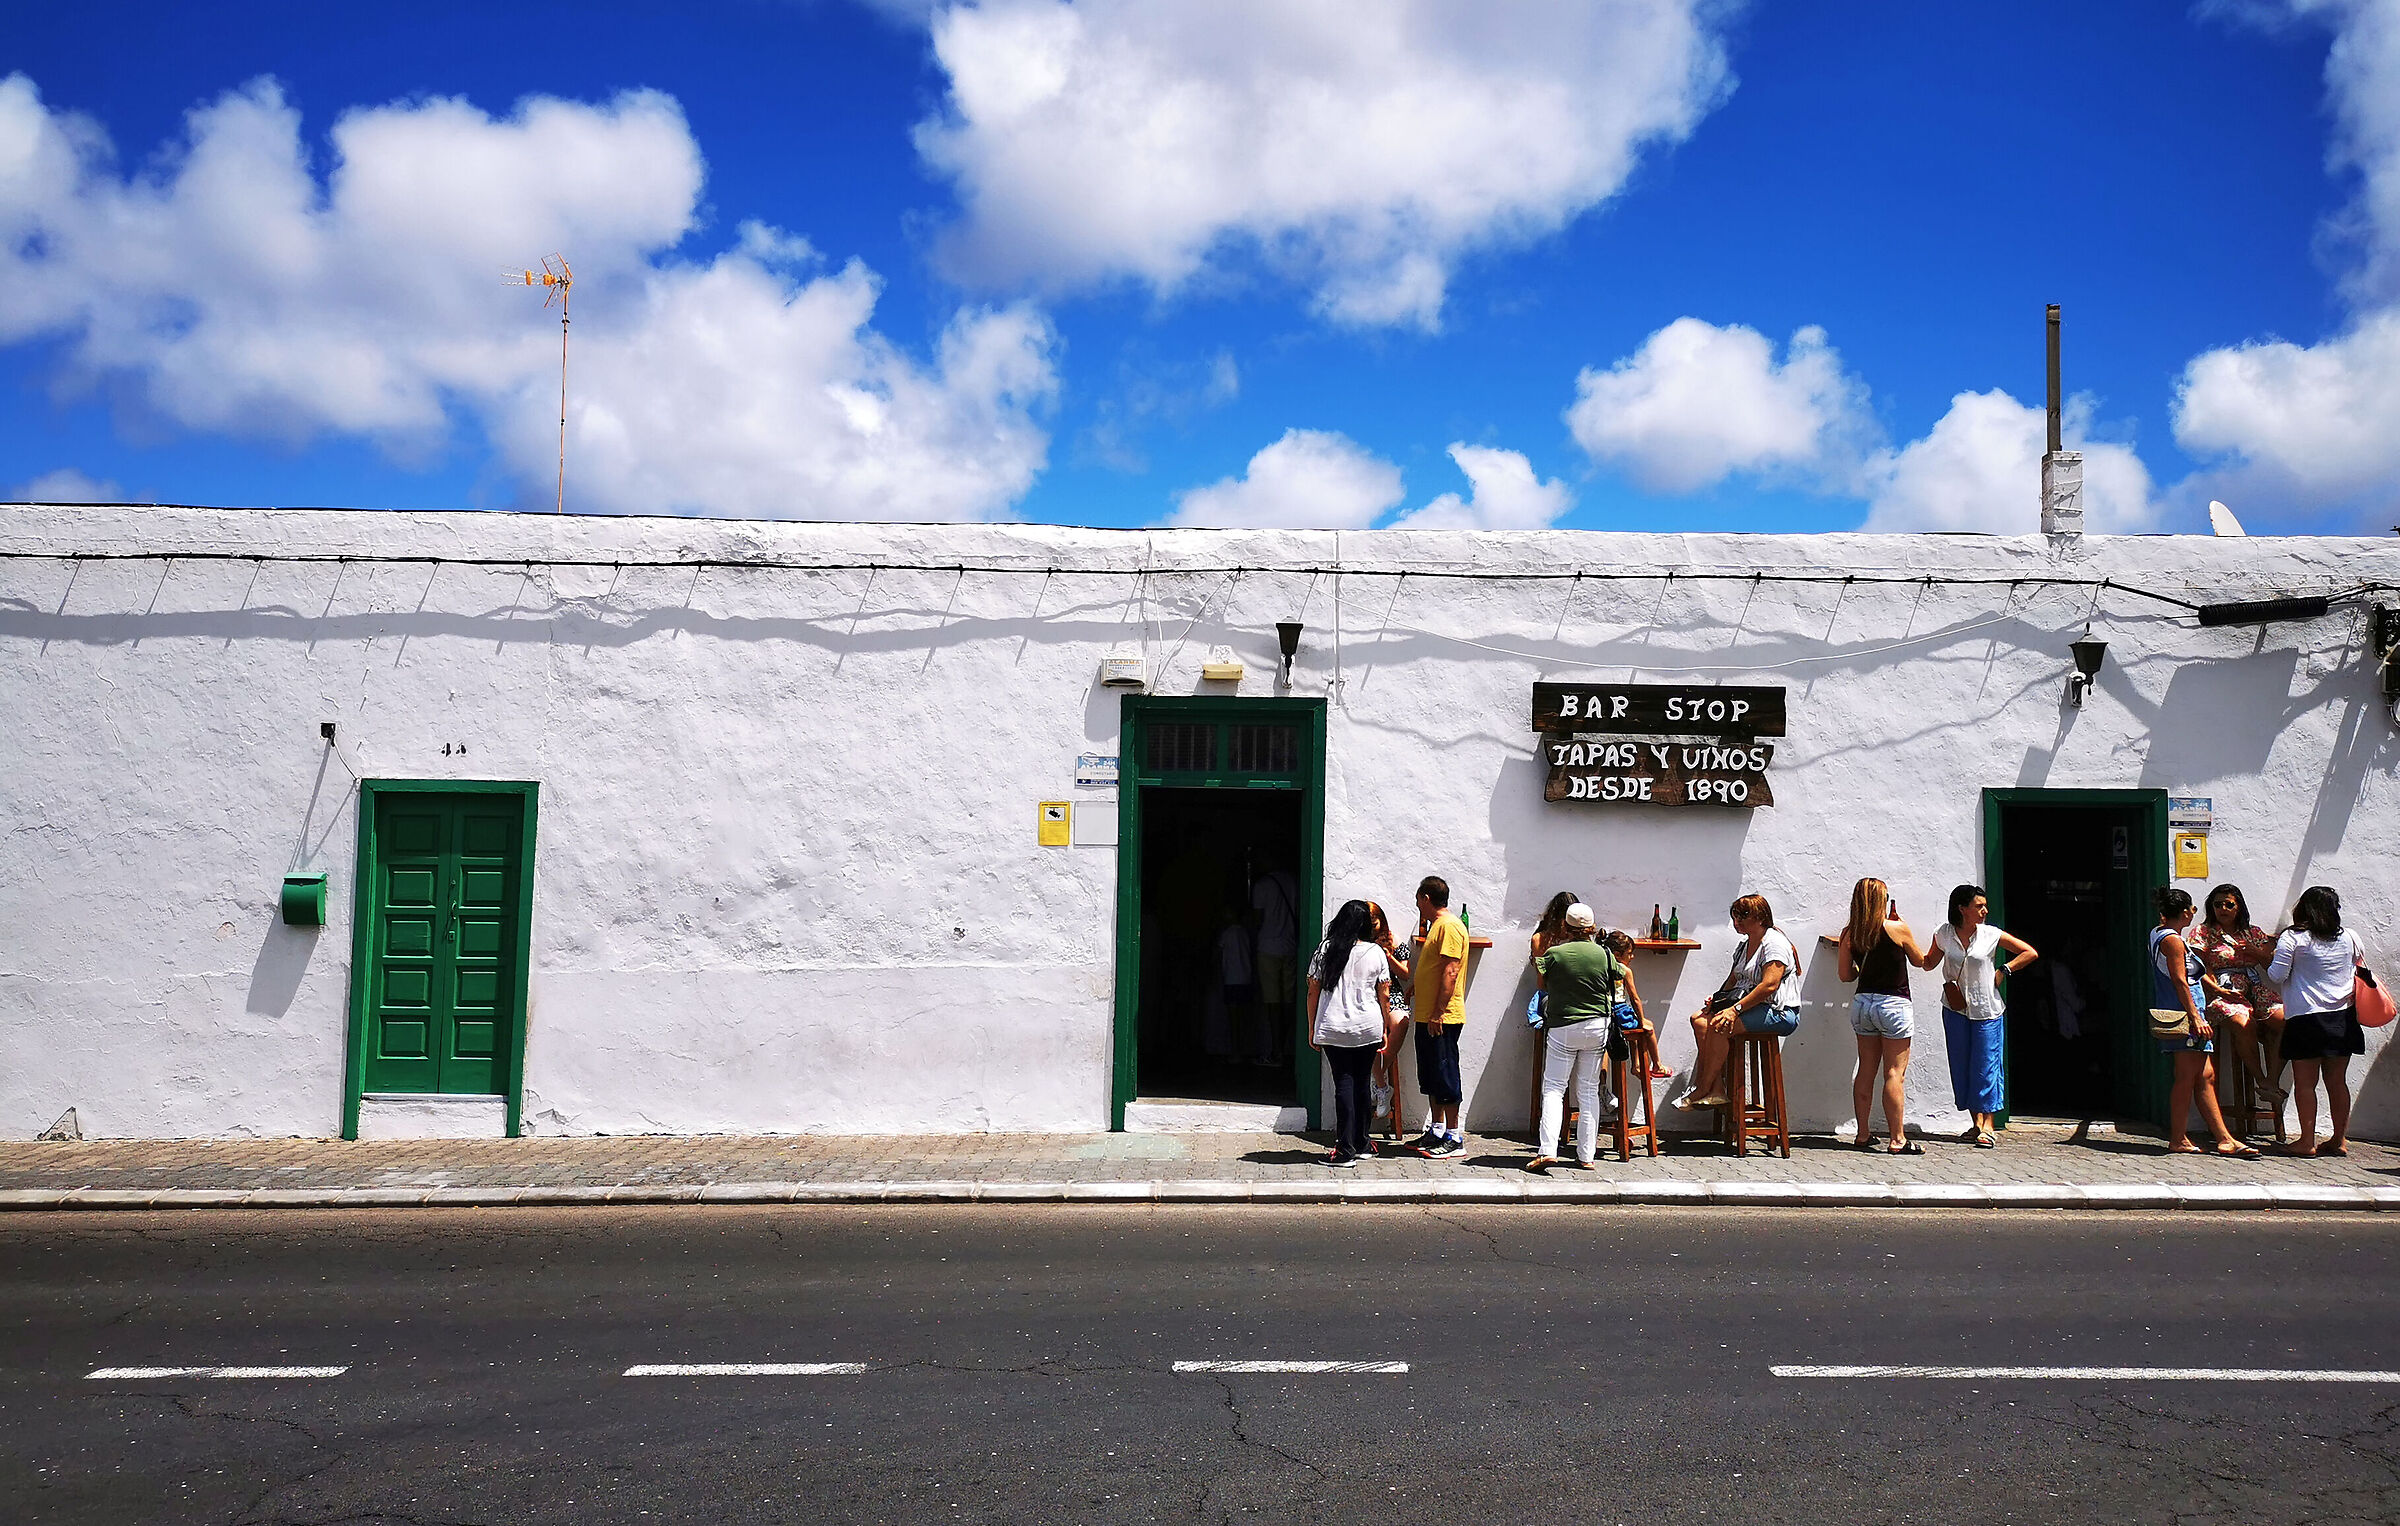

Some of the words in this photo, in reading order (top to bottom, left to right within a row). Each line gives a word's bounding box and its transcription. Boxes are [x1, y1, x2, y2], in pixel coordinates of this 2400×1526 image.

[1560, 694, 1629, 718] BAR
[1665, 697, 1750, 722] STOP
[1552, 743, 1638, 767] TAPAS
[1650, 744, 1670, 769] Y
[1566, 775, 1655, 801] DESDE
[1685, 778, 1748, 803] 1890
